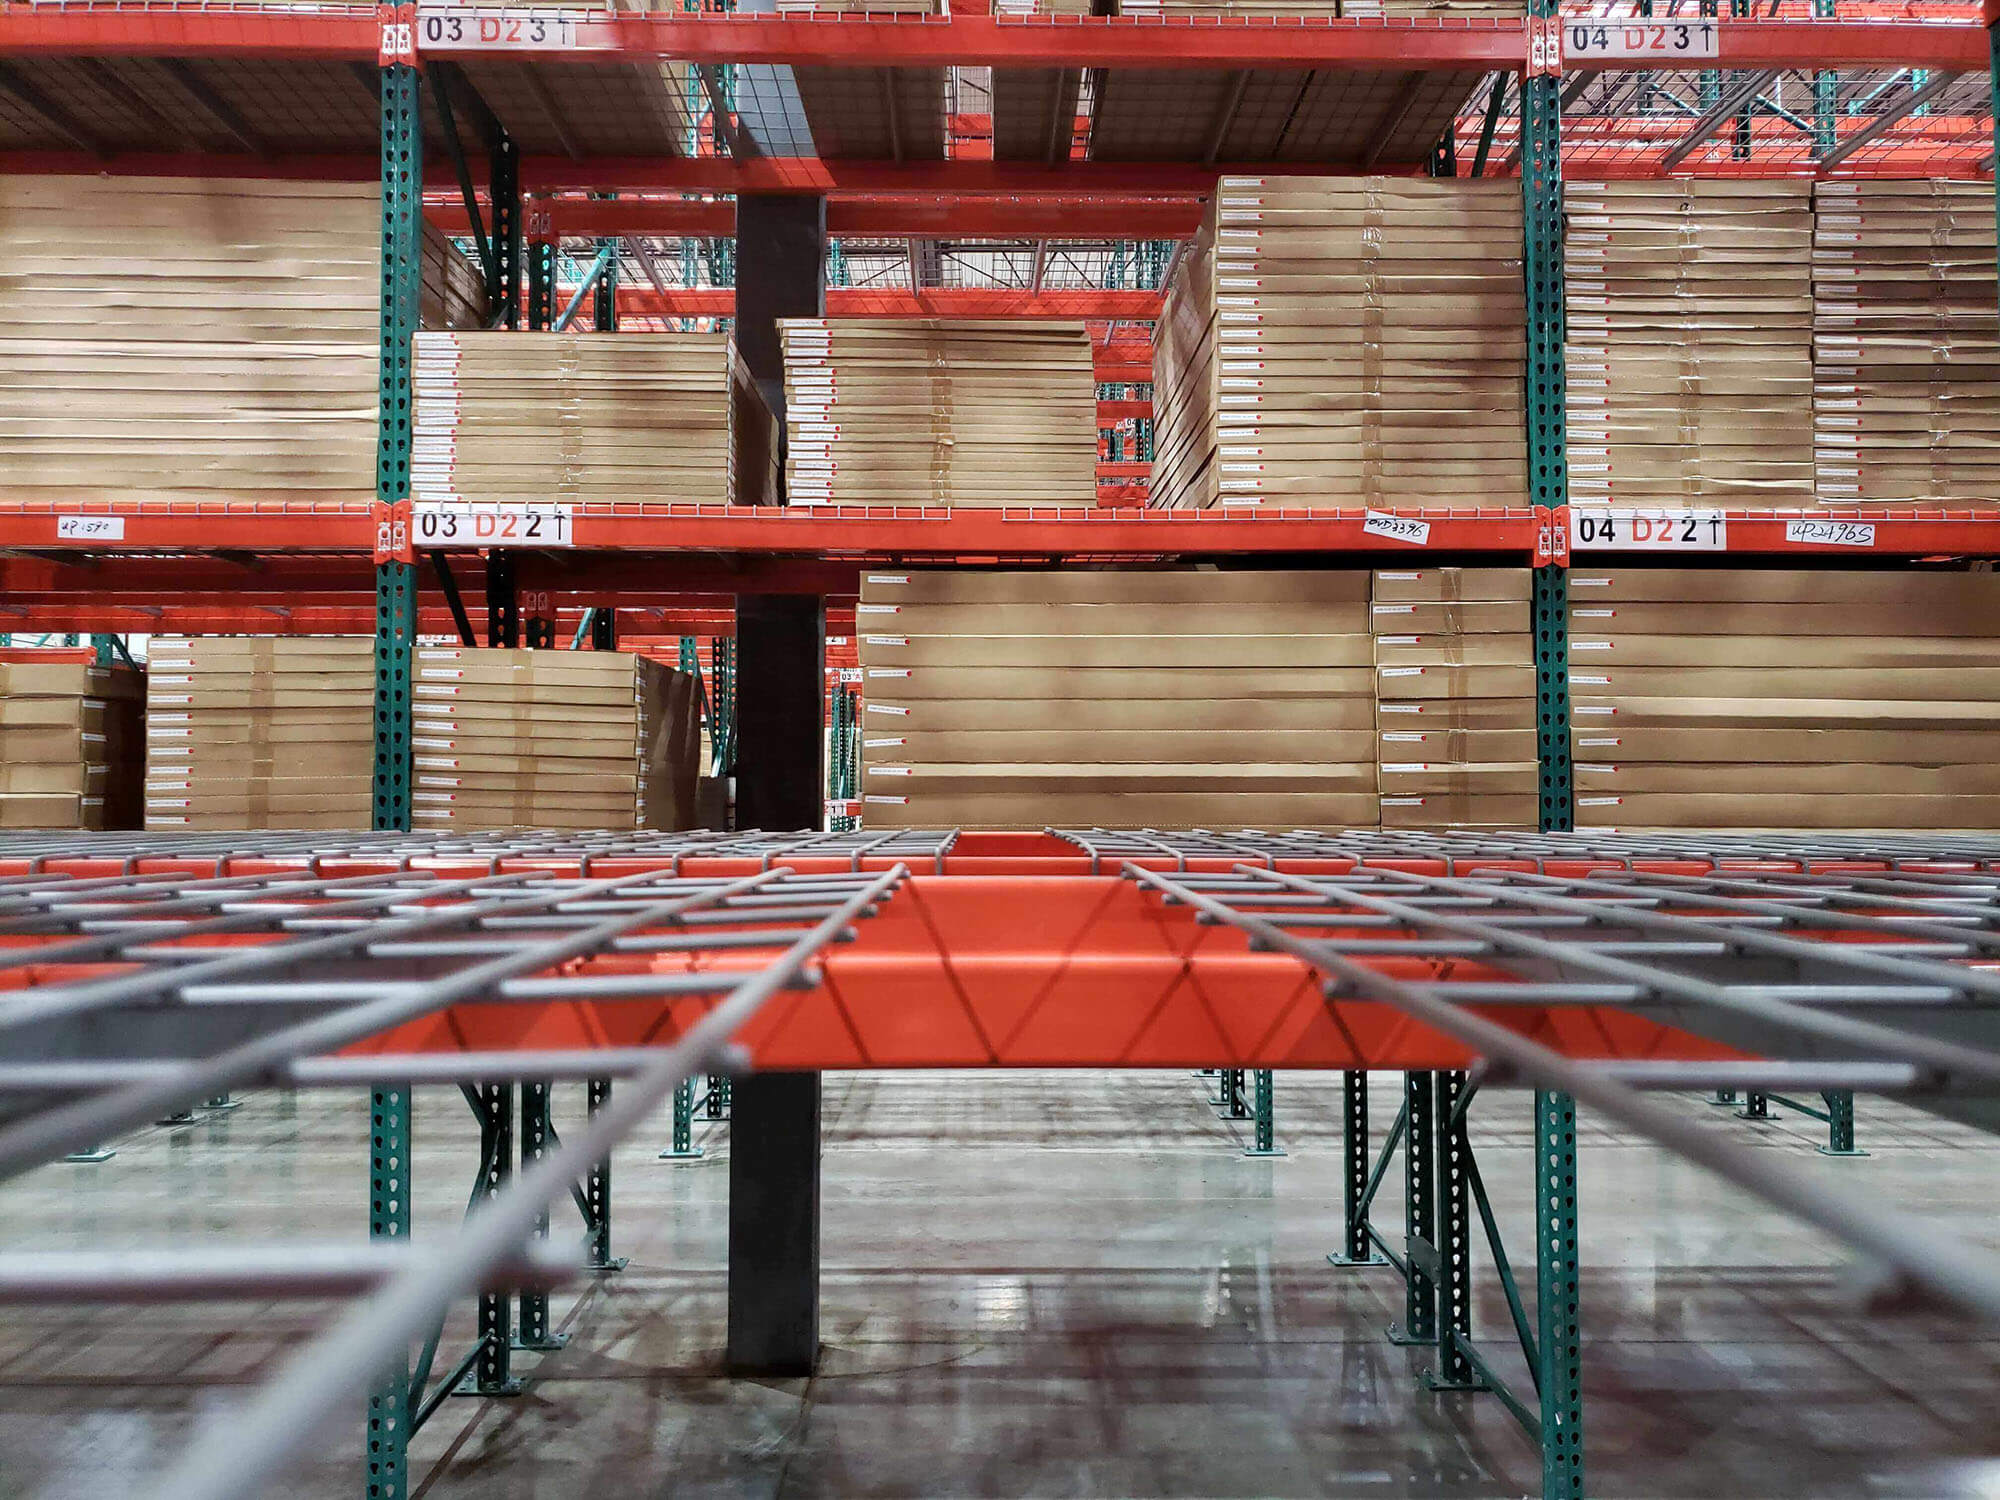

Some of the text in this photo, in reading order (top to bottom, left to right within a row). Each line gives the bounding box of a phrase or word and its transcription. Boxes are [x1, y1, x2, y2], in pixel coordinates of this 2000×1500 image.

[427, 17, 463, 42] 03
[1572, 26, 1609, 50] 04
[421, 511, 458, 537] 03
[1579, 516, 1616, 542] 04
